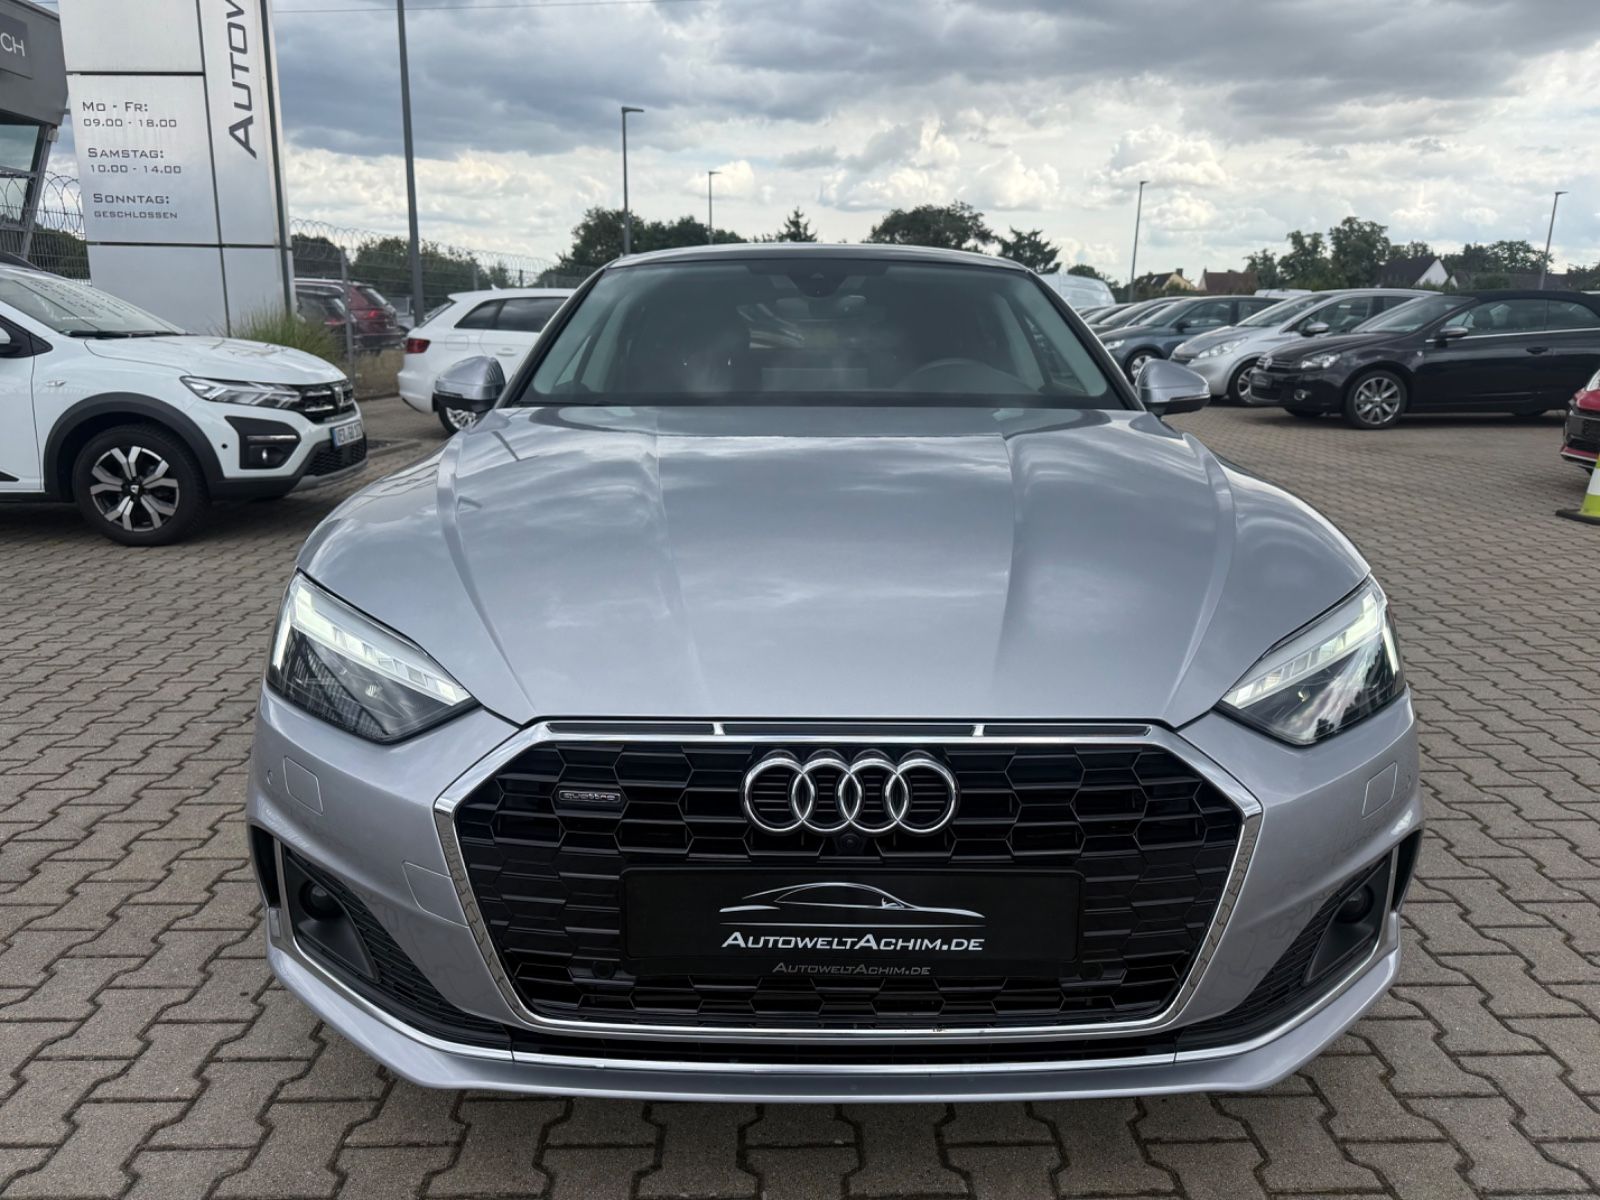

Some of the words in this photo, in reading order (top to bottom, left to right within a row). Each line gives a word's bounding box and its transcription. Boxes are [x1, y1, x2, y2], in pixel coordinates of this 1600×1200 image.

[83, 118, 123, 128] 09.00
[138, 119, 177, 128] 18.00
[87, 147, 164, 159] SAMSTAG:
[90, 164, 129, 174] 10.00
[143, 165, 182, 174] 14.00
[93, 193, 170, 205] SONNTAG:
[93, 210, 178, 220] GESCHLOSSEN
